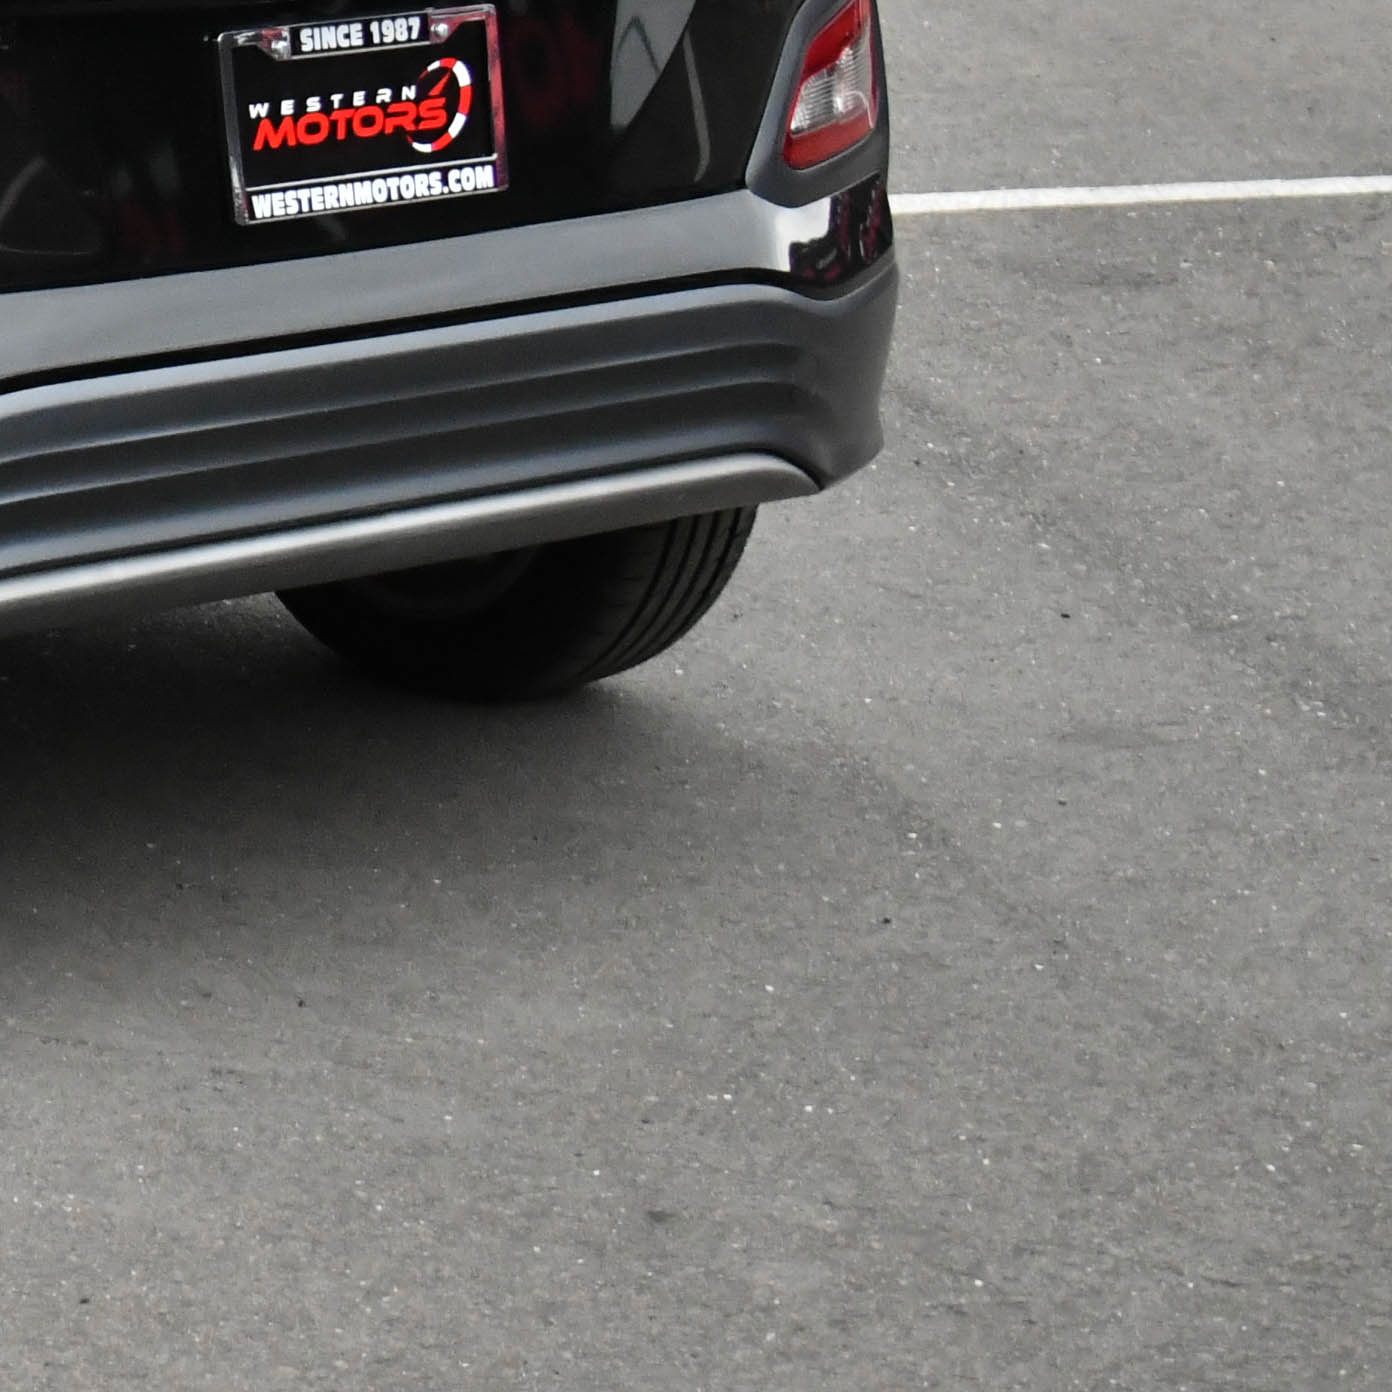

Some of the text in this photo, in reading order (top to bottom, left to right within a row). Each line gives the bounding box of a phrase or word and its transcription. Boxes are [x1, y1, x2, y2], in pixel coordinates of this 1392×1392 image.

[300, 16, 422, 54] SINCE 1987
[249, 85, 418, 119] WESTERN
[253, 97, 447, 151] MOTORS
[251, 165, 495, 220] WESTERNMOTORS.COM
